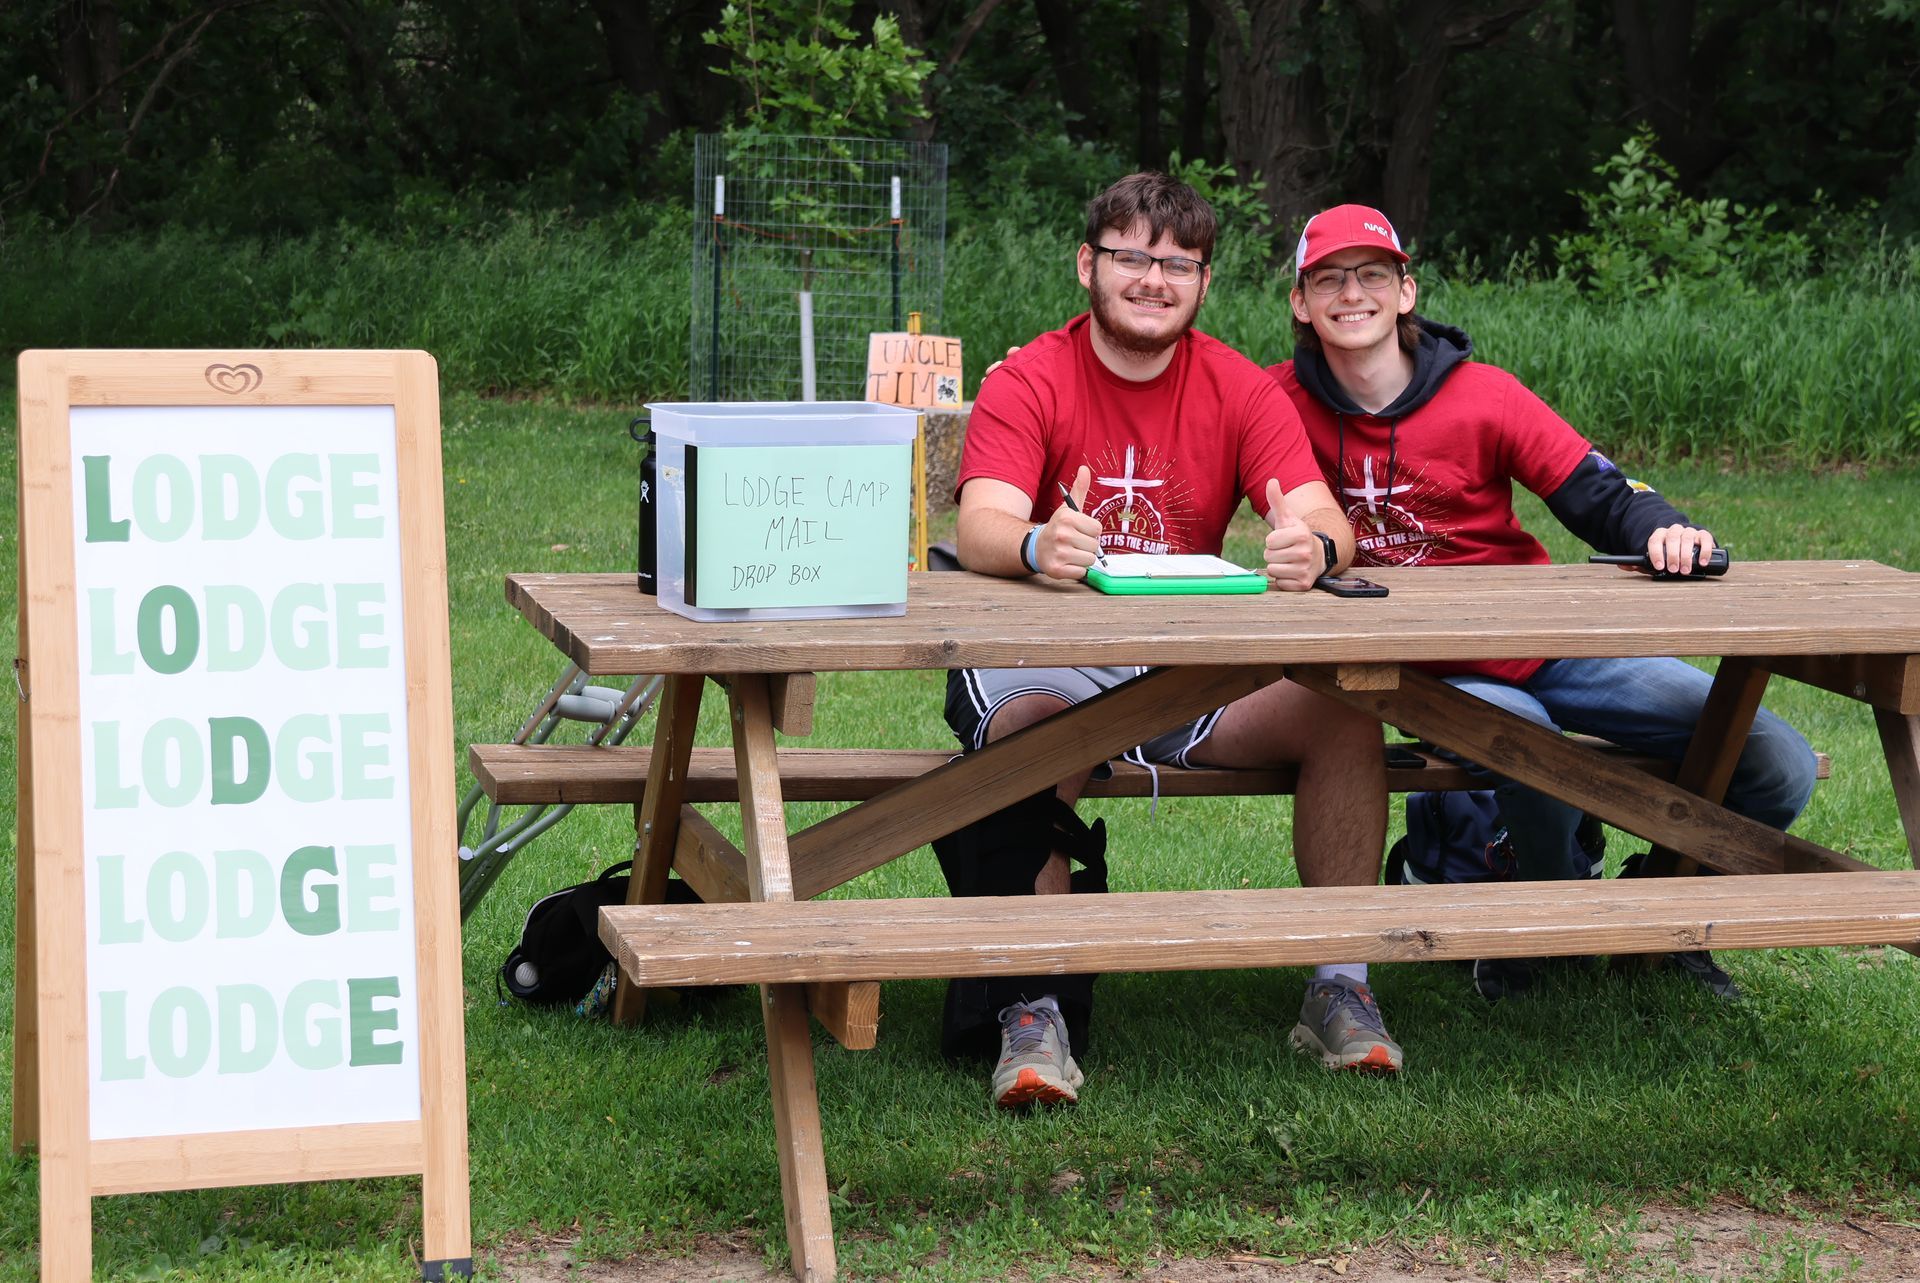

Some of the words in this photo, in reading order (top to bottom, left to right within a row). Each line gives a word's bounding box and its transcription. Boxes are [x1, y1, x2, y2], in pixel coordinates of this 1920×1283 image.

[1364, 222, 1390, 240] NASA
[883, 340, 960, 368] UNCLE
[869, 371, 936, 406] TIM
[82, 452, 385, 543] LODGE
[724, 472, 805, 508] LODGE
[826, 475, 890, 508] CAMP
[764, 516, 843, 552] MAIL
[1138, 499, 1161, 536] TODAY
[1113, 534, 1125, 546] IS
[1126, 536, 1143, 551] THE
[1142, 540, 1169, 555] SAME
[1375, 535, 1387, 548] IS
[1387, 532, 1408, 546] THE
[730, 563, 777, 592] DROP
[788, 564, 822, 586] BOX
[87, 582, 390, 676] LODGE
[91, 713, 395, 810] LODGE
[96, 843, 400, 945] LODGE
[98, 976, 404, 1082] LODGE
